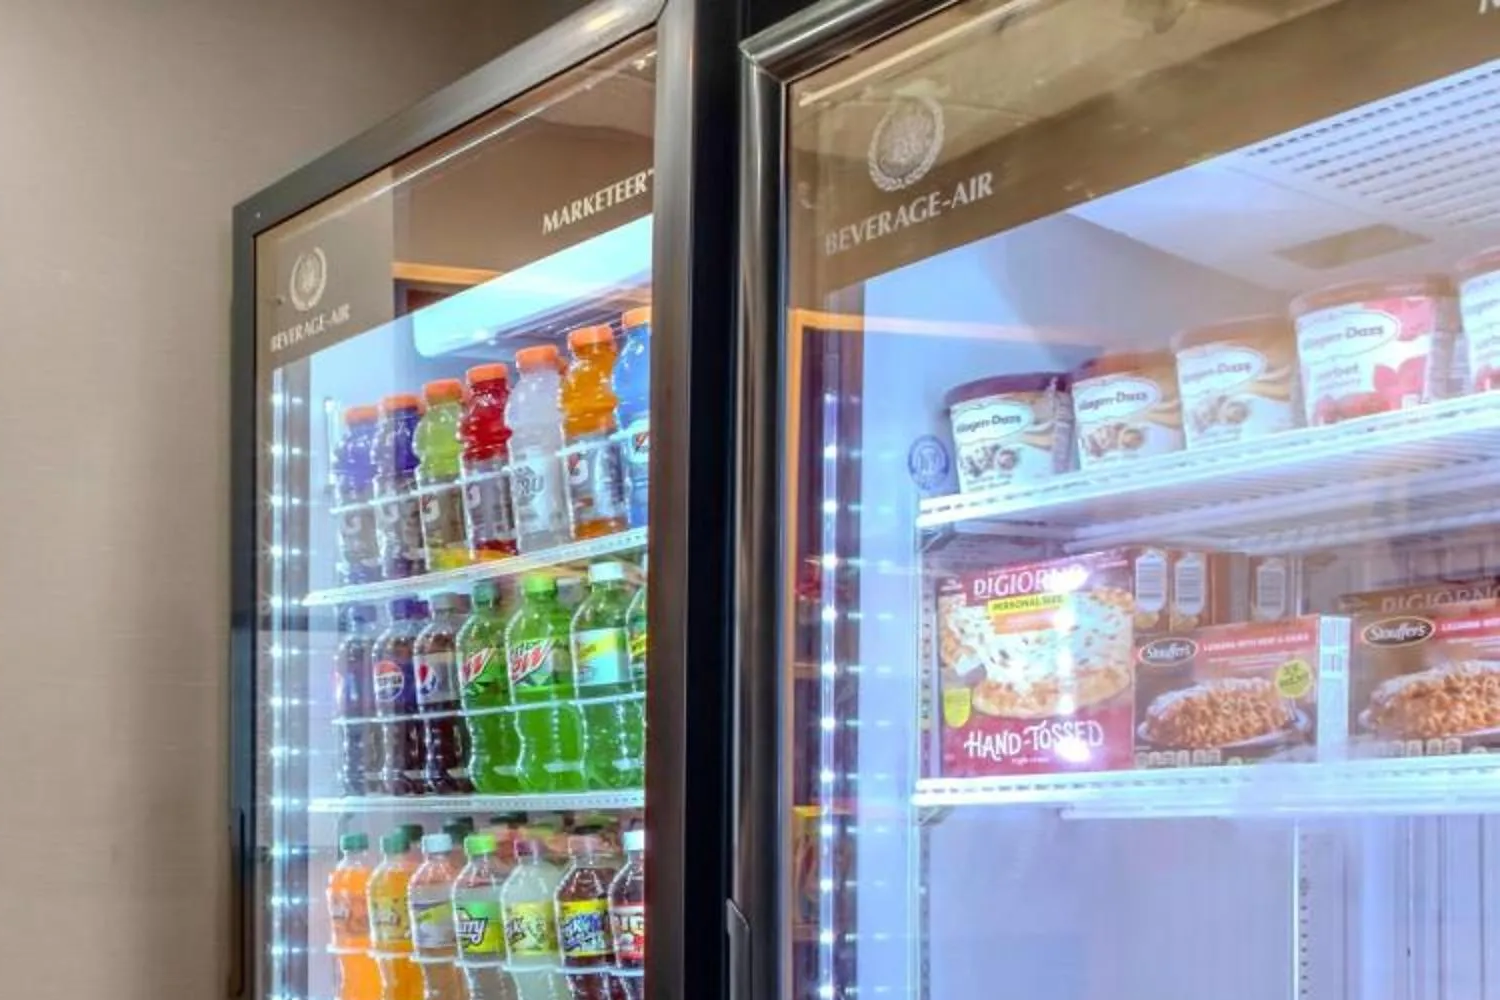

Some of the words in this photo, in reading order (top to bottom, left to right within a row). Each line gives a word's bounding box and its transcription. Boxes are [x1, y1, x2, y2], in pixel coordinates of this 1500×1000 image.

[825, 171, 994, 256] BEVERAGE-AIR
[270, 302, 351, 353] BEVERAGE-AIR
[973, 562, 1090, 597] DIGIOR
